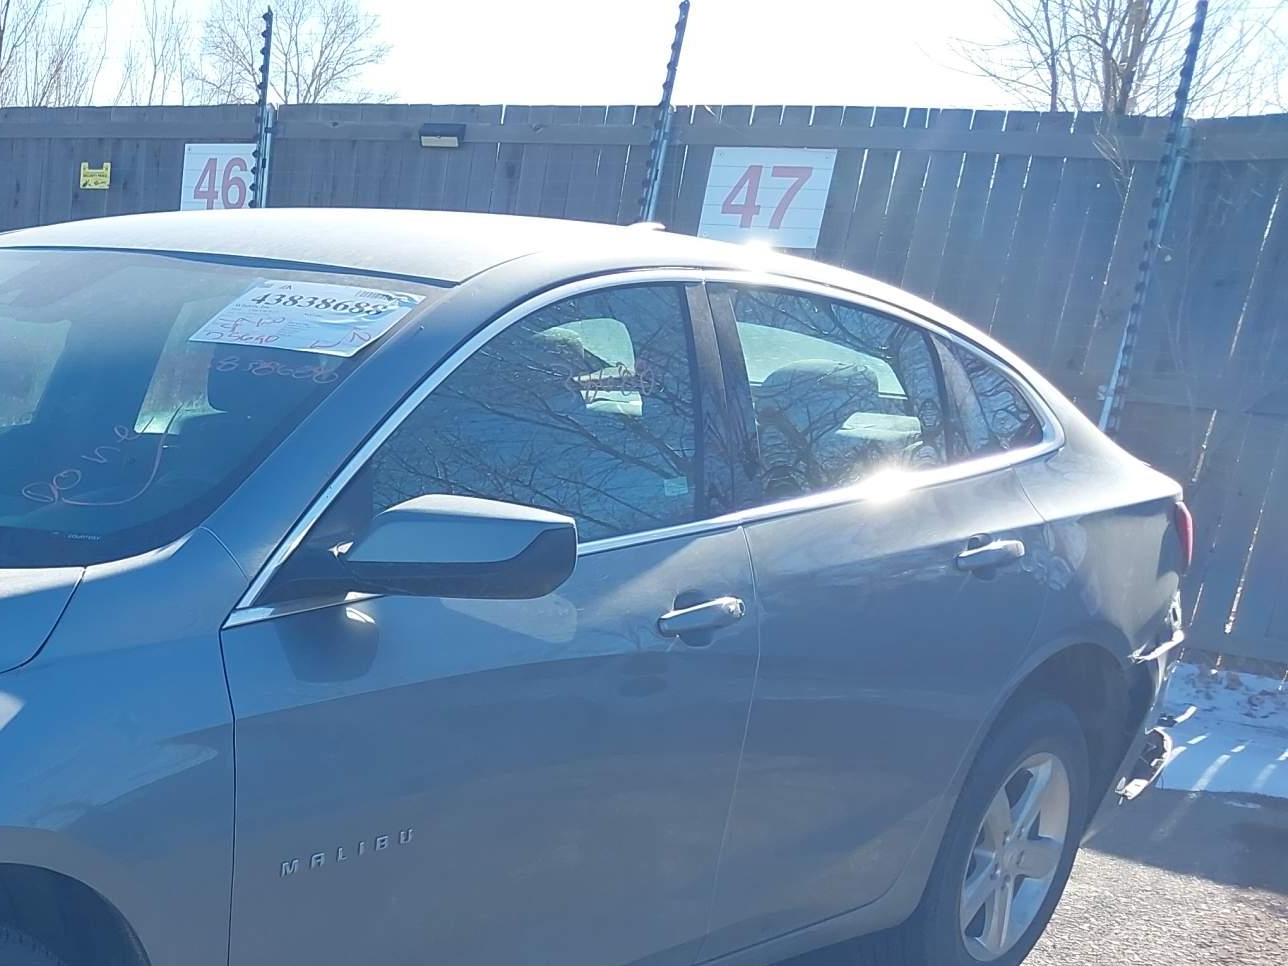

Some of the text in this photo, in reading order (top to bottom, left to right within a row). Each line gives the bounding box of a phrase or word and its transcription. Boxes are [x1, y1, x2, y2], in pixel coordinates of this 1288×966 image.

[193, 157, 248, 210] 46
[720, 164, 814, 230] 47
[250, 292, 389, 316] 43838688
[280, 828, 416, 878] MALIBU
